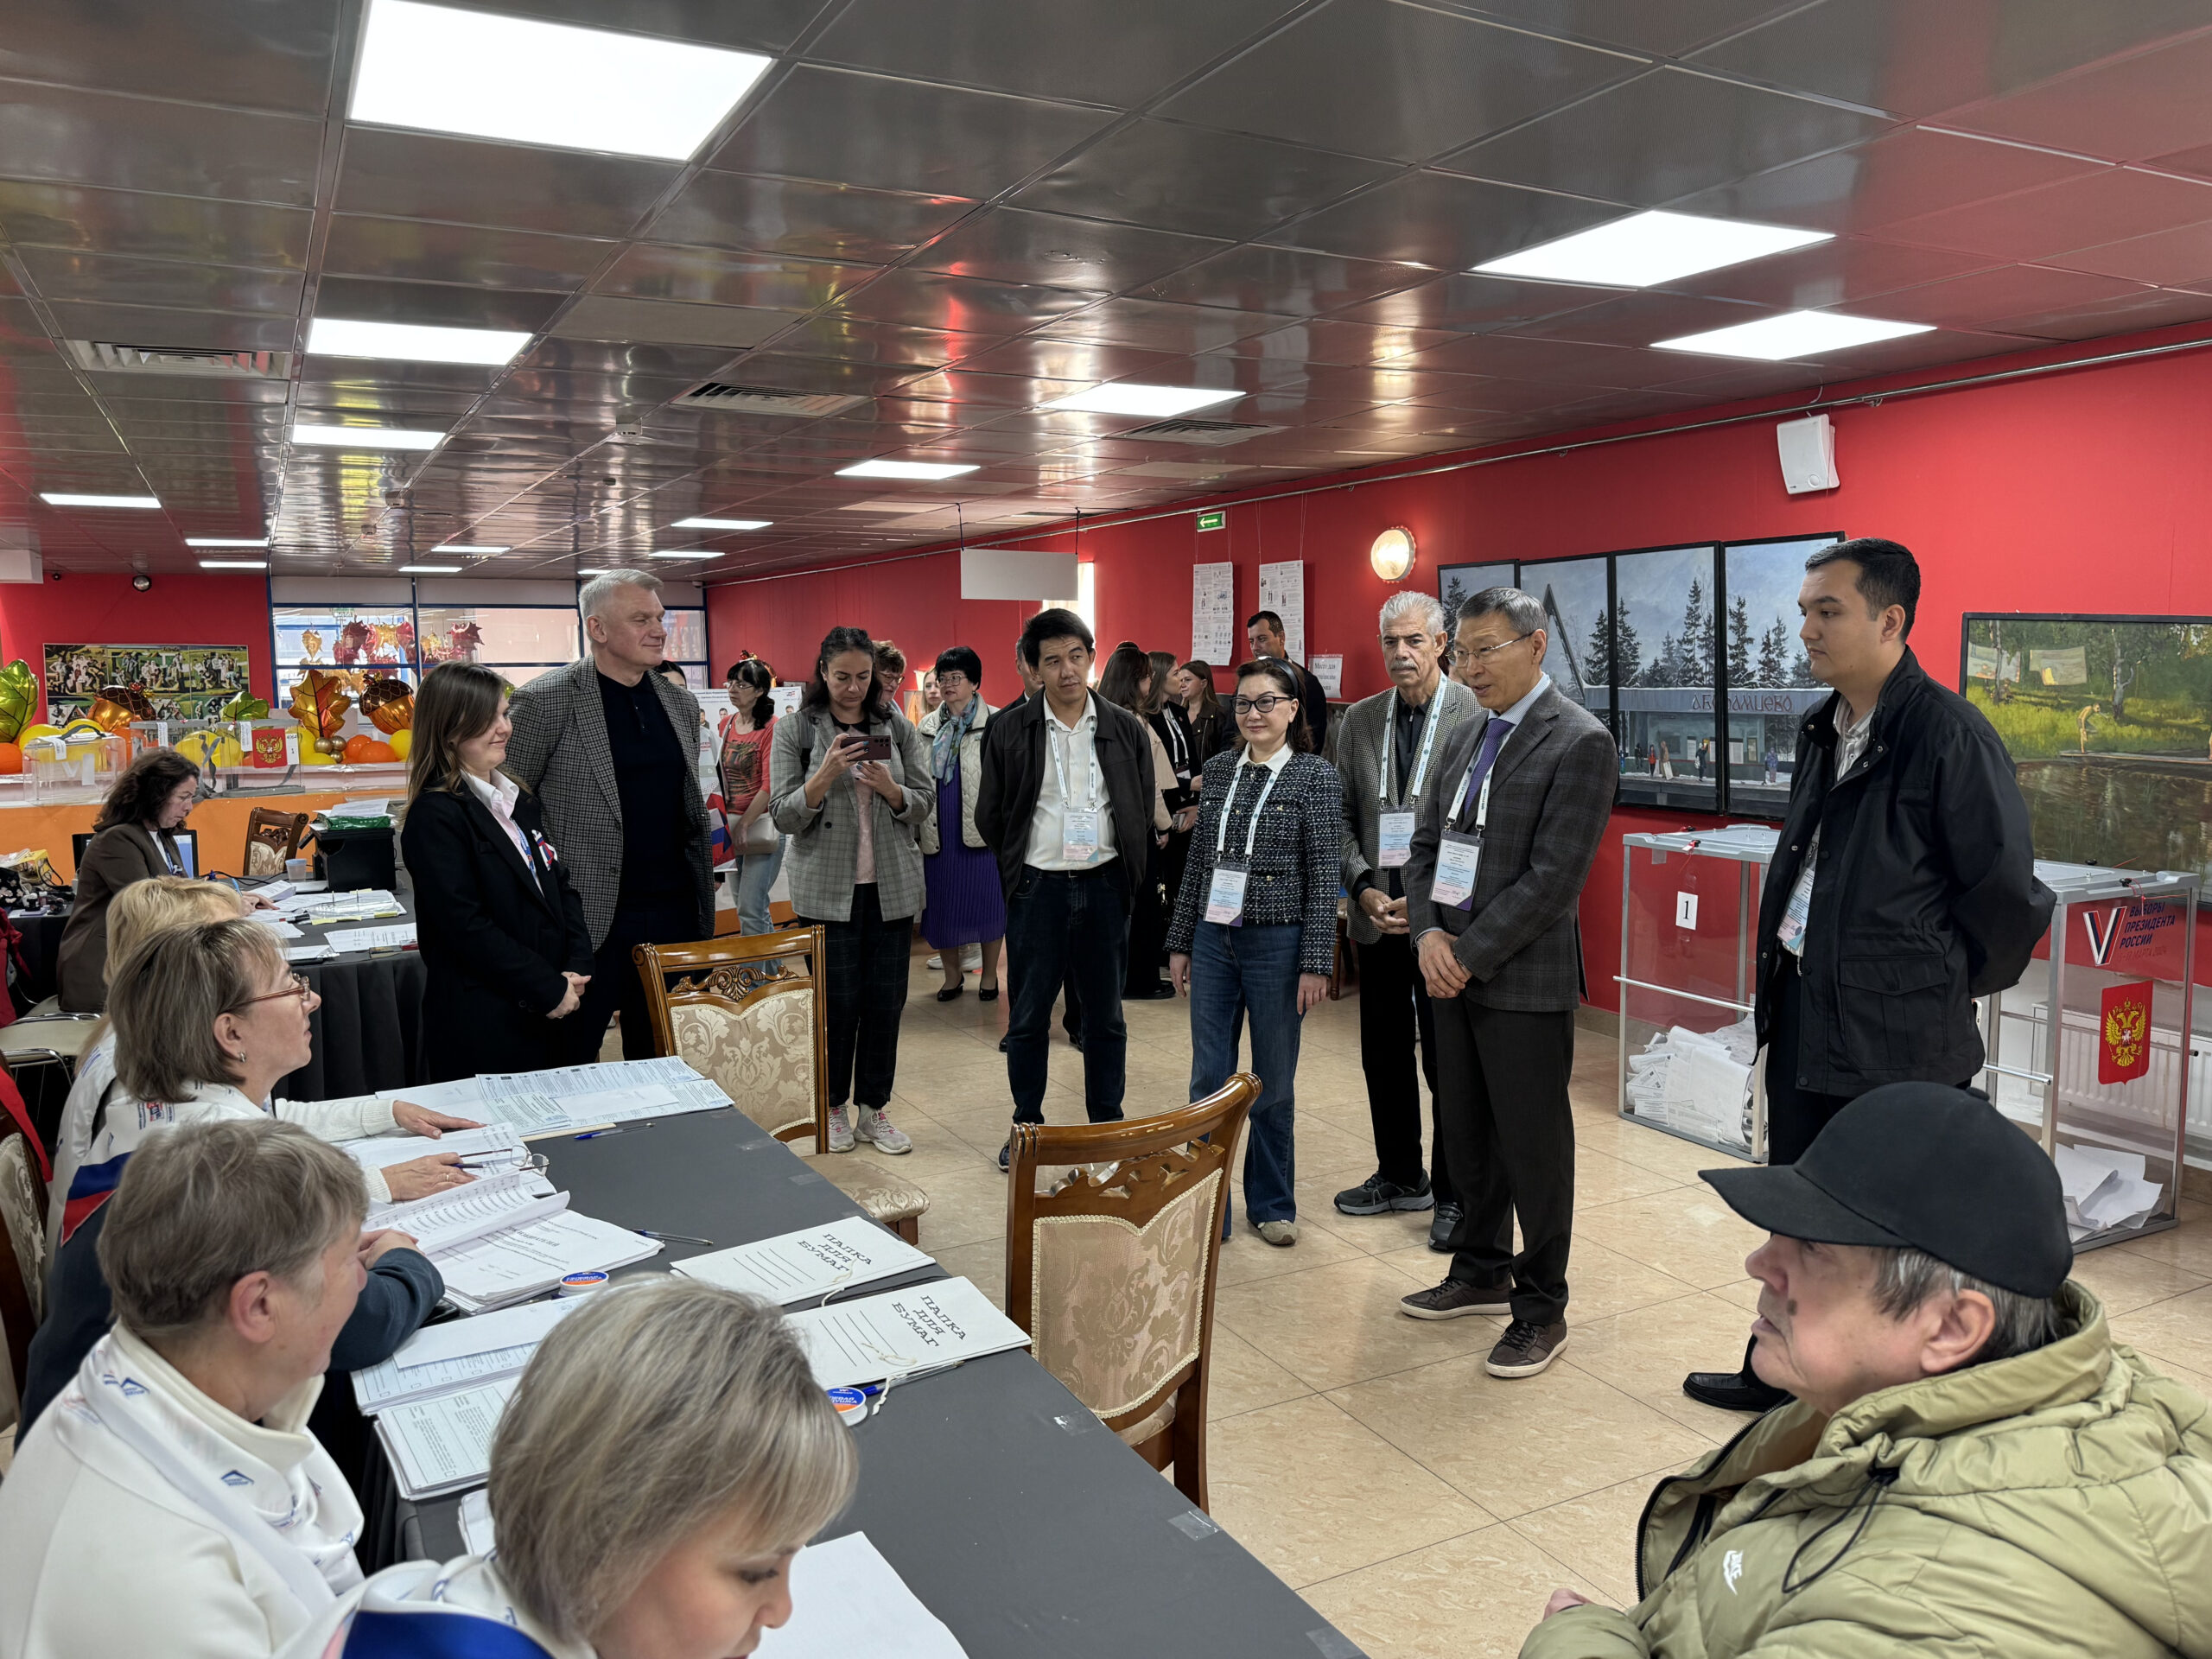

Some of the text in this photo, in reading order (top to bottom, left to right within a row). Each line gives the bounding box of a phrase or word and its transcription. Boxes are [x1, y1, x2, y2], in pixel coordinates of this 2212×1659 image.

[1683, 900, 1689, 919] 1
[2129, 901, 2165, 918] ВЫБОРЫ
[2125, 915, 2176, 933] ПРЕЗИДЕНТА
[2120, 933, 2153, 949] РОССИИ
[797, 1239, 850, 1272] БУМАГ
[817, 1243, 852, 1264] ДЛЯ
[823, 1232, 873, 1266] ПАПКА
[892, 1301, 940, 1348] БУМАГ
[912, 1309, 946, 1335] ДЛЯ
[920, 1294, 968, 1341] ПАПКА
